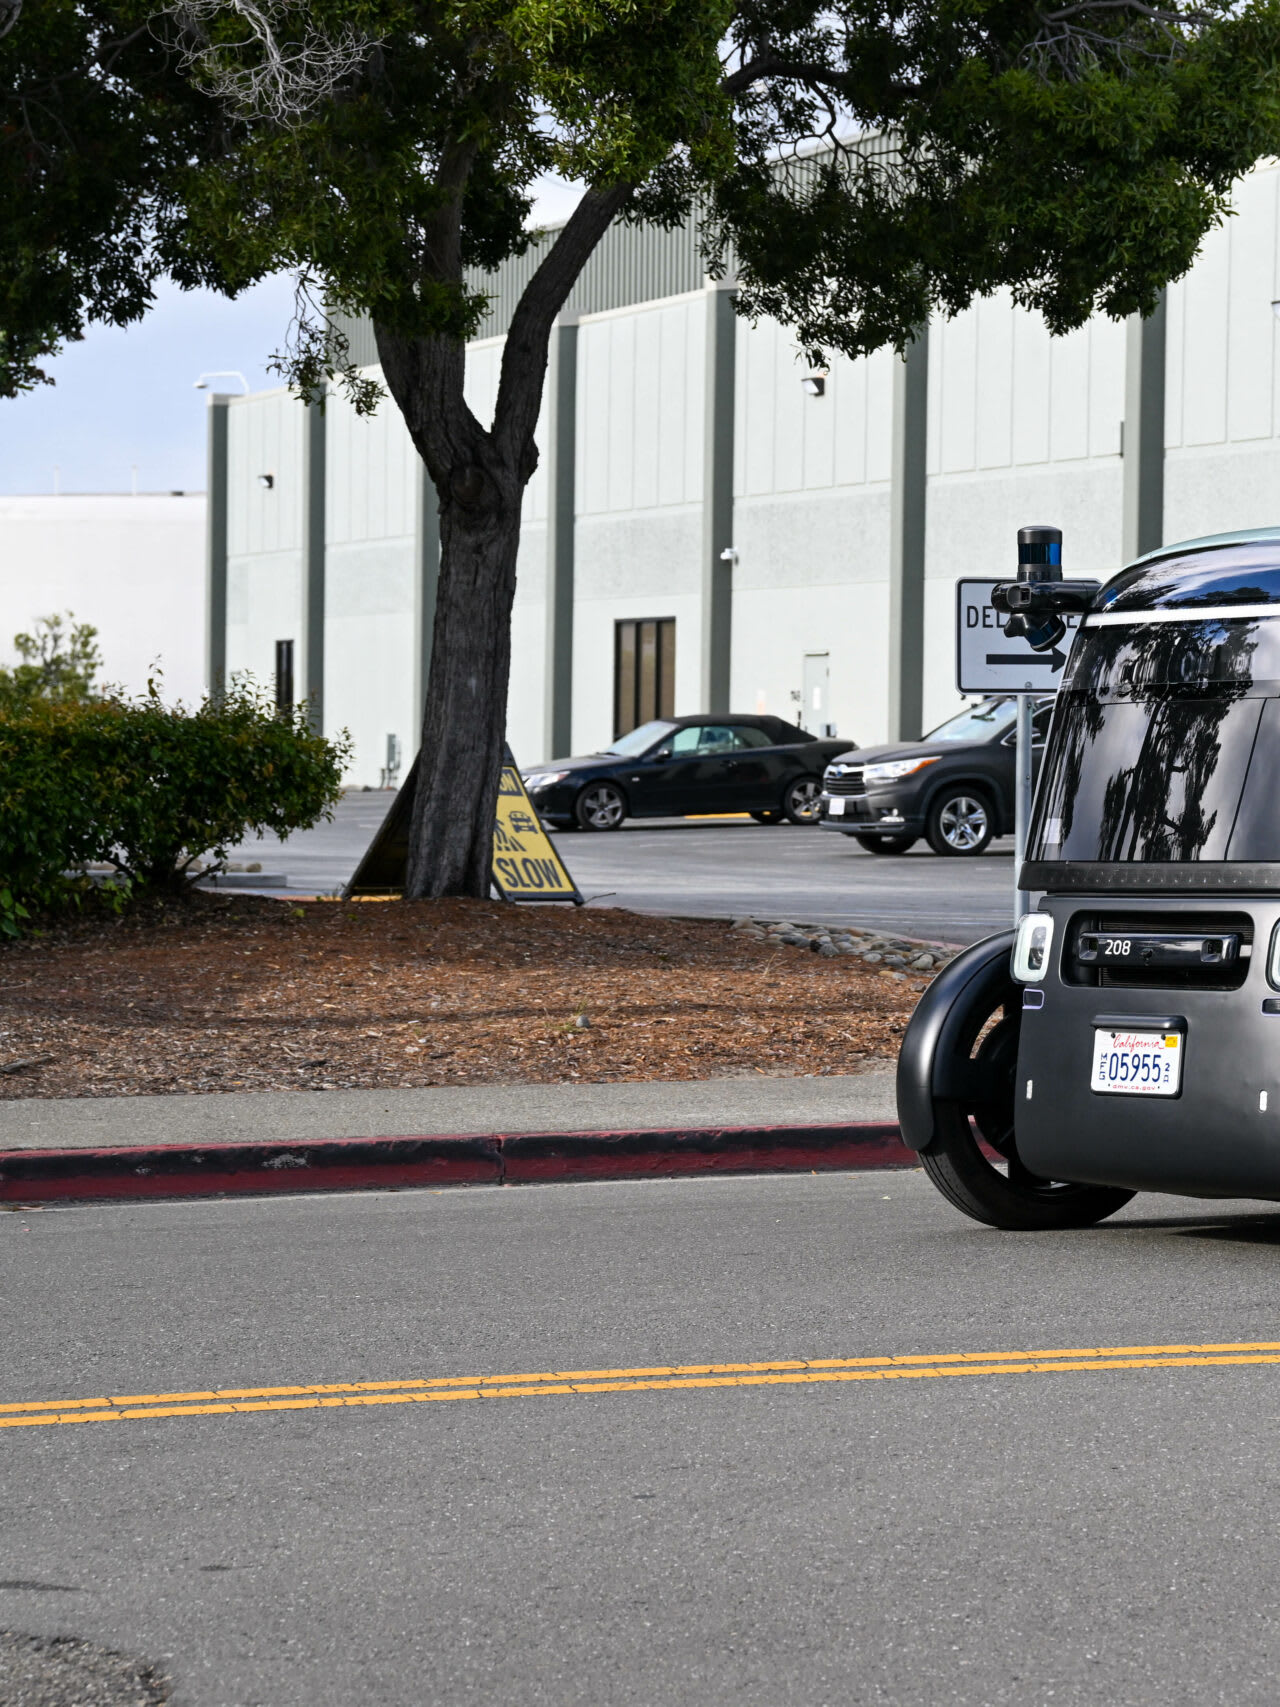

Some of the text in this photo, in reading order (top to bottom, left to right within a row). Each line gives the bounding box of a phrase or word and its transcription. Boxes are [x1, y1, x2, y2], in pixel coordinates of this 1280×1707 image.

[496, 858, 563, 888] SLOW
[1105, 940, 1131, 956] 208
[1113, 1034, 1164, 1053] California
[1109, 1053, 1161, 1082] 05955
